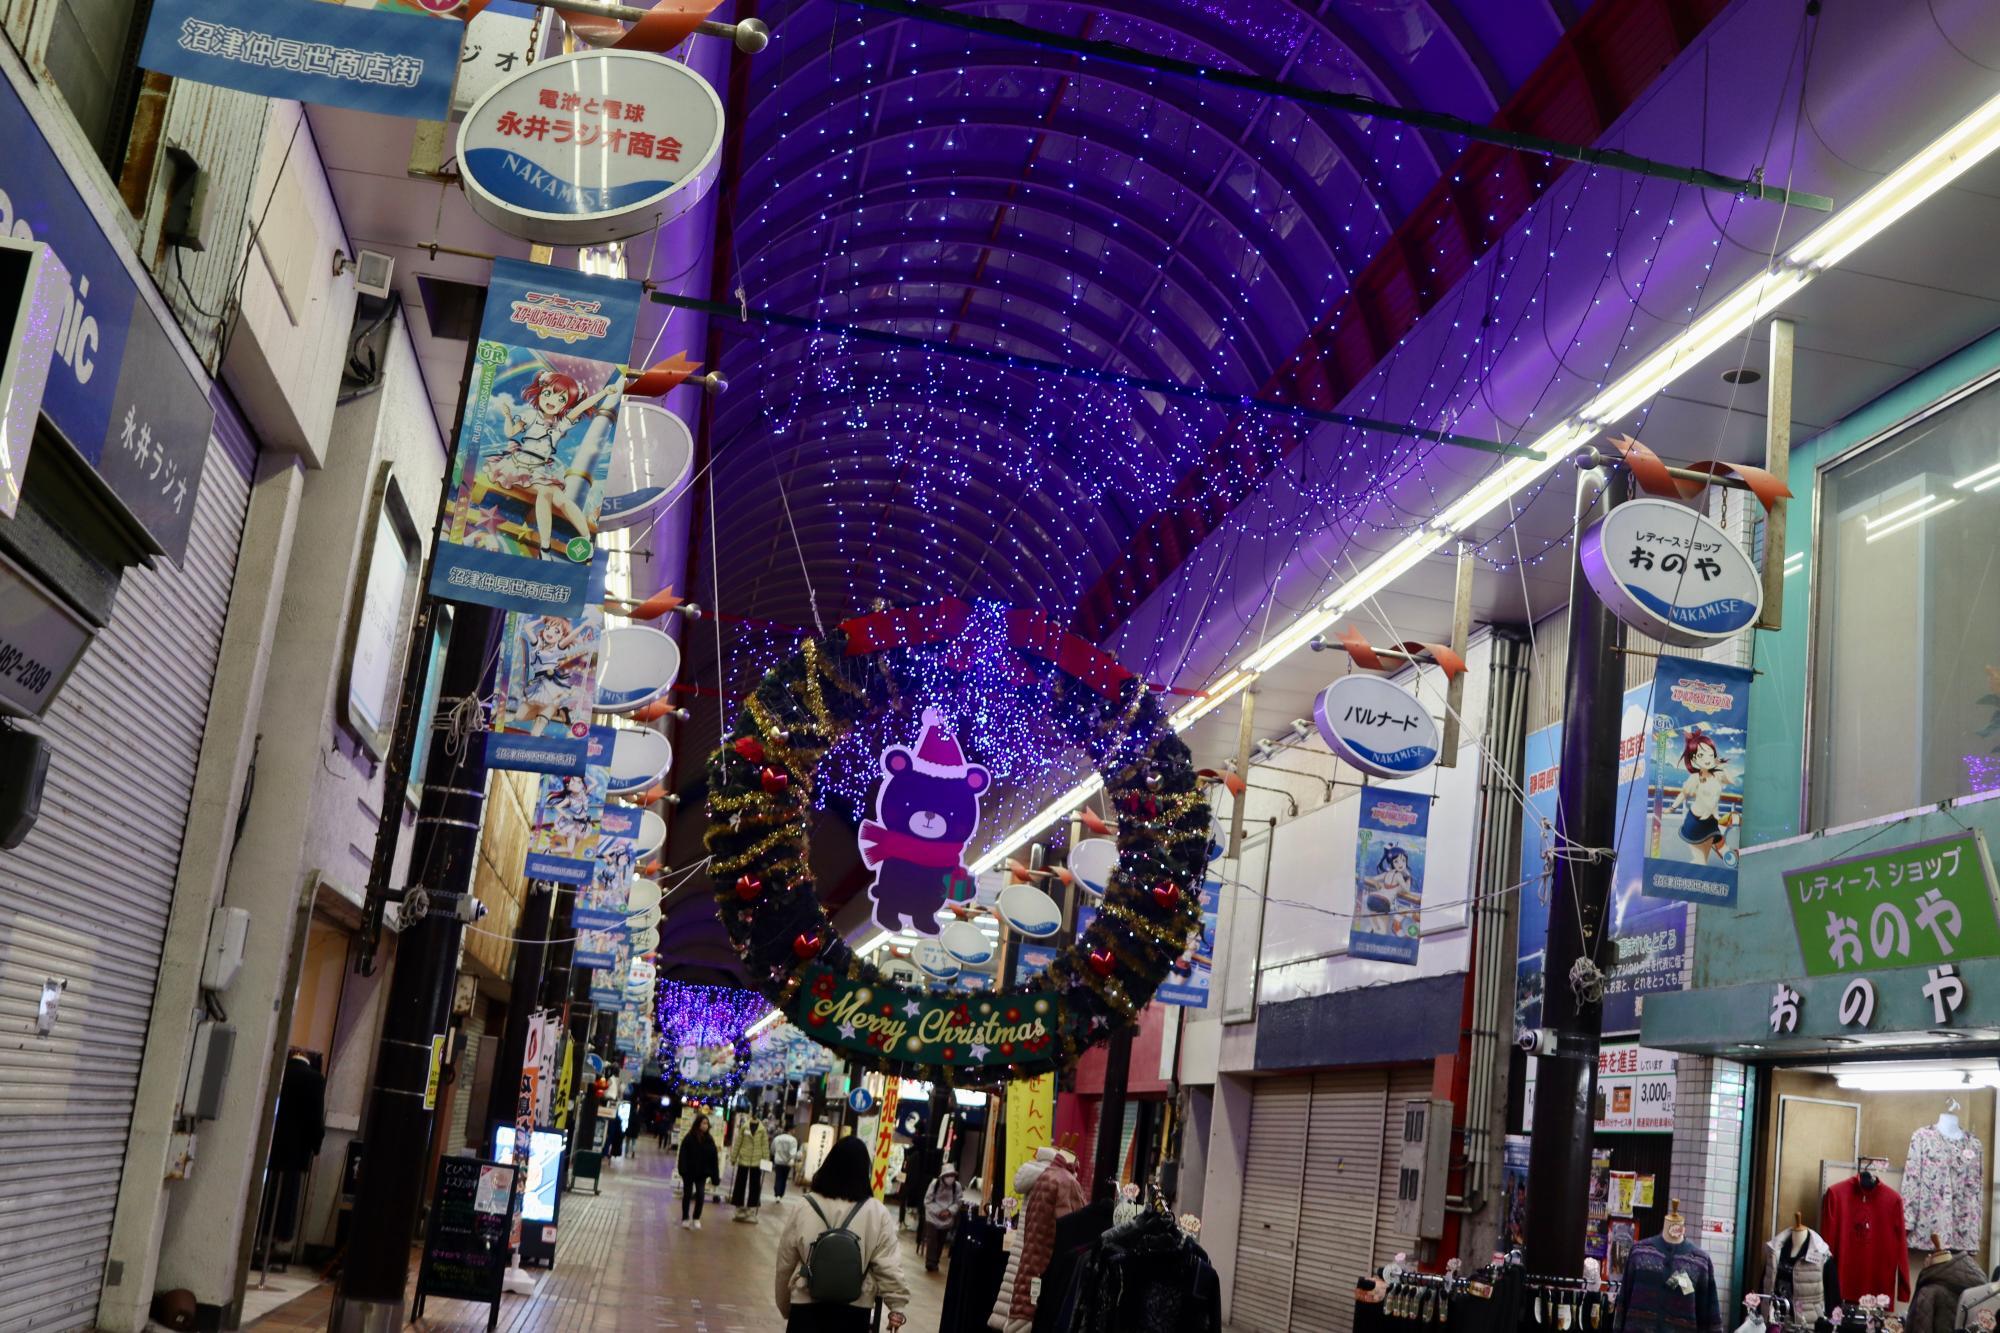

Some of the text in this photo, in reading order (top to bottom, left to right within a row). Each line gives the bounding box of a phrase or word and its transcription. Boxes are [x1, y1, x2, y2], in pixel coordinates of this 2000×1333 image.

[178, 17, 423, 88] 沼津仲見世商店街
[539, 88, 646, 122] 電池と電球
[497, 111, 683, 162] 永井ラジオ商会
[502, 153, 608, 207] NAKAMSE
[122, 405, 187, 514] 永井ラジオ
[448, 566, 571, 604] 沼津仲見世商店街
[1629, 546, 1722, 581] おのや
[1673, 601, 1740, 623] NAKAMISE
[1372, 747, 1424, 764] NAKAMISE
[1800, 846, 1962, 903] レディース ショップ
[1825, 888, 1962, 969] おのや
[814, 991, 1046, 1053] Merry Christmas
[1770, 964, 1964, 1033] おのや
